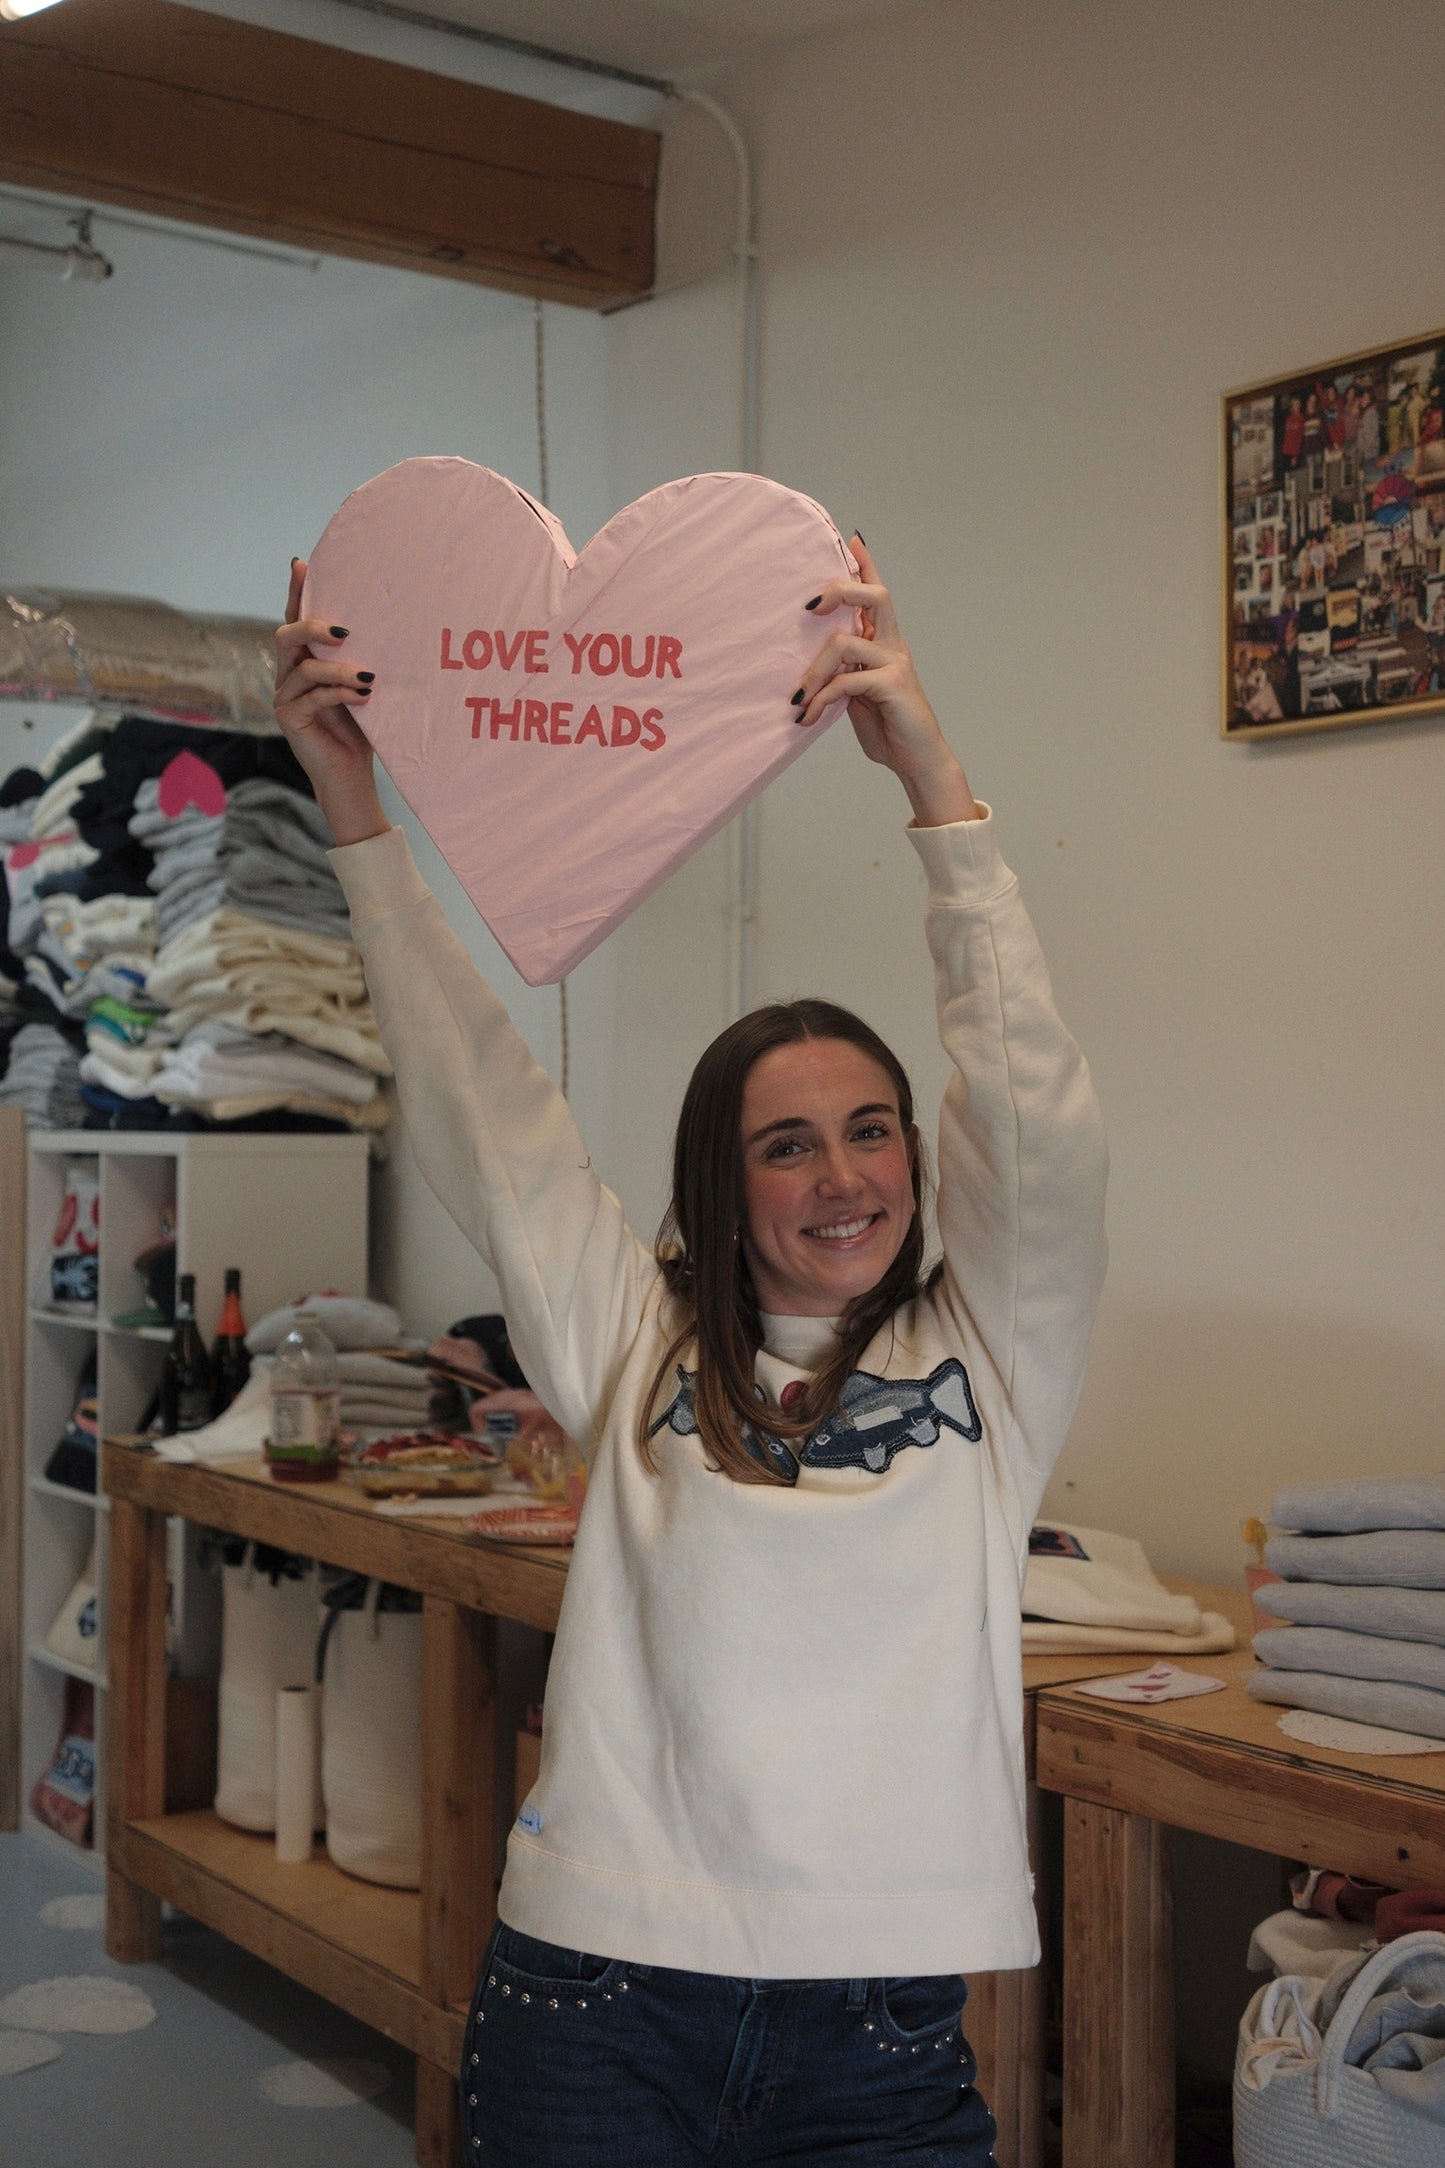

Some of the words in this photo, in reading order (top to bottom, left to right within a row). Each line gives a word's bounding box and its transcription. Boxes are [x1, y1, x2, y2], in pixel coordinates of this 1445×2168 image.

[440, 628, 549, 673] LOVE
[563, 632, 683, 679] YOUR
[464, 697, 666, 751] THREADS
